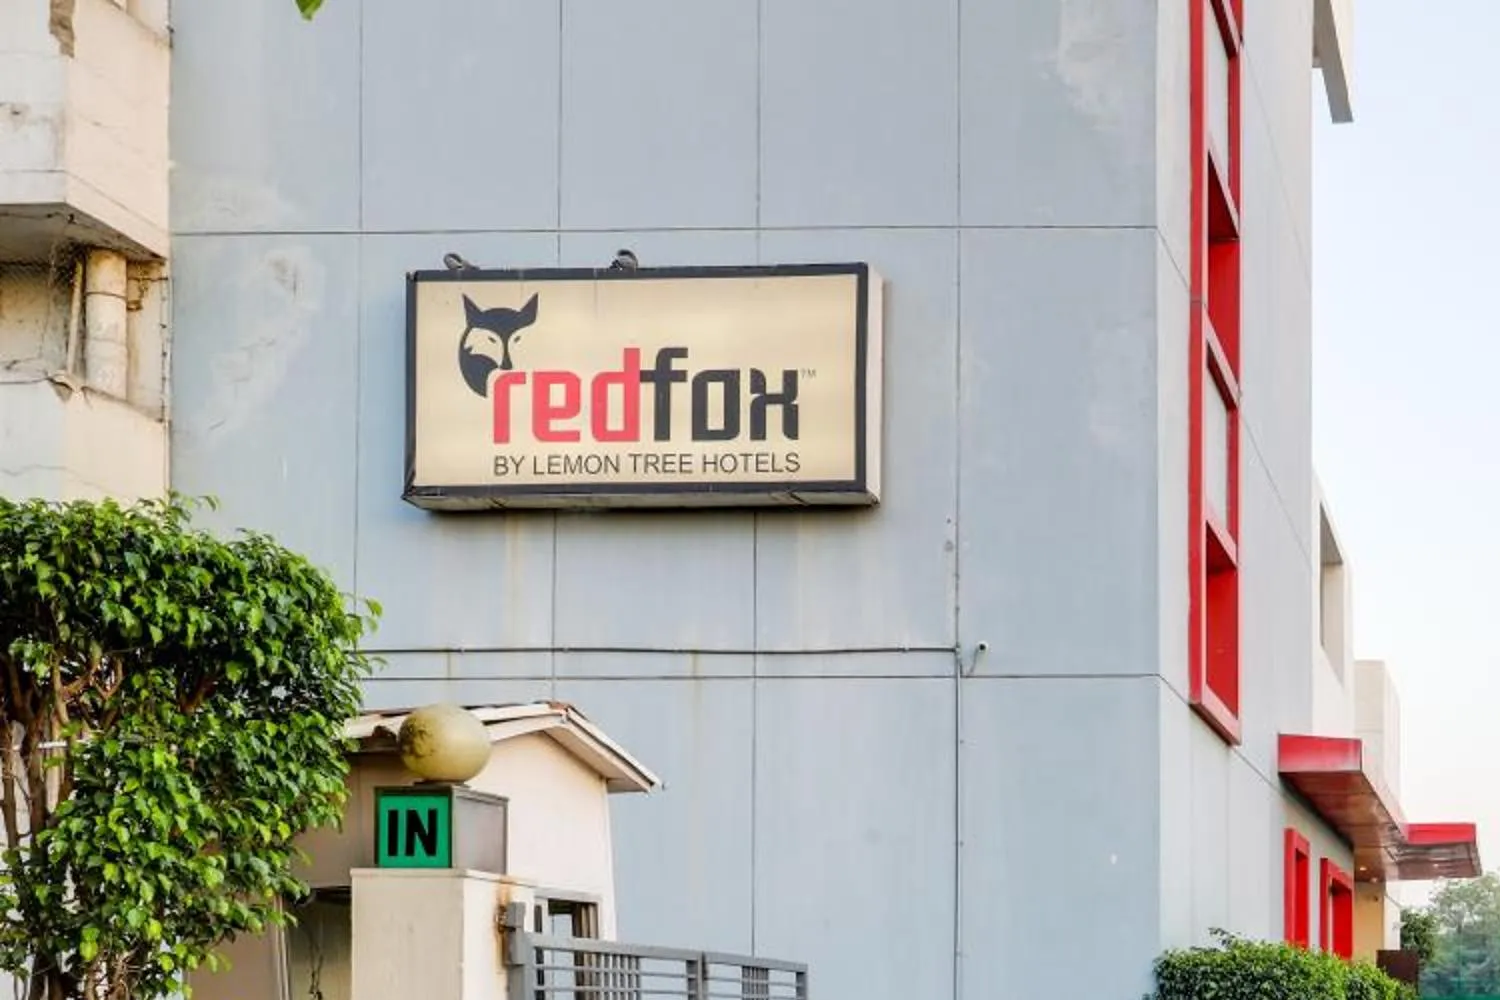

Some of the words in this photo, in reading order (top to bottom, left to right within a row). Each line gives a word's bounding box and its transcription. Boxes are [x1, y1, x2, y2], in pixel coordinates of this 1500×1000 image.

[492, 346, 800, 445] redfox
[494, 455, 525, 476] BY
[533, 455, 621, 475] LEMON
[629, 454, 693, 474] TREE
[702, 452, 801, 474] HOTELS
[387, 808, 438, 857] IN
